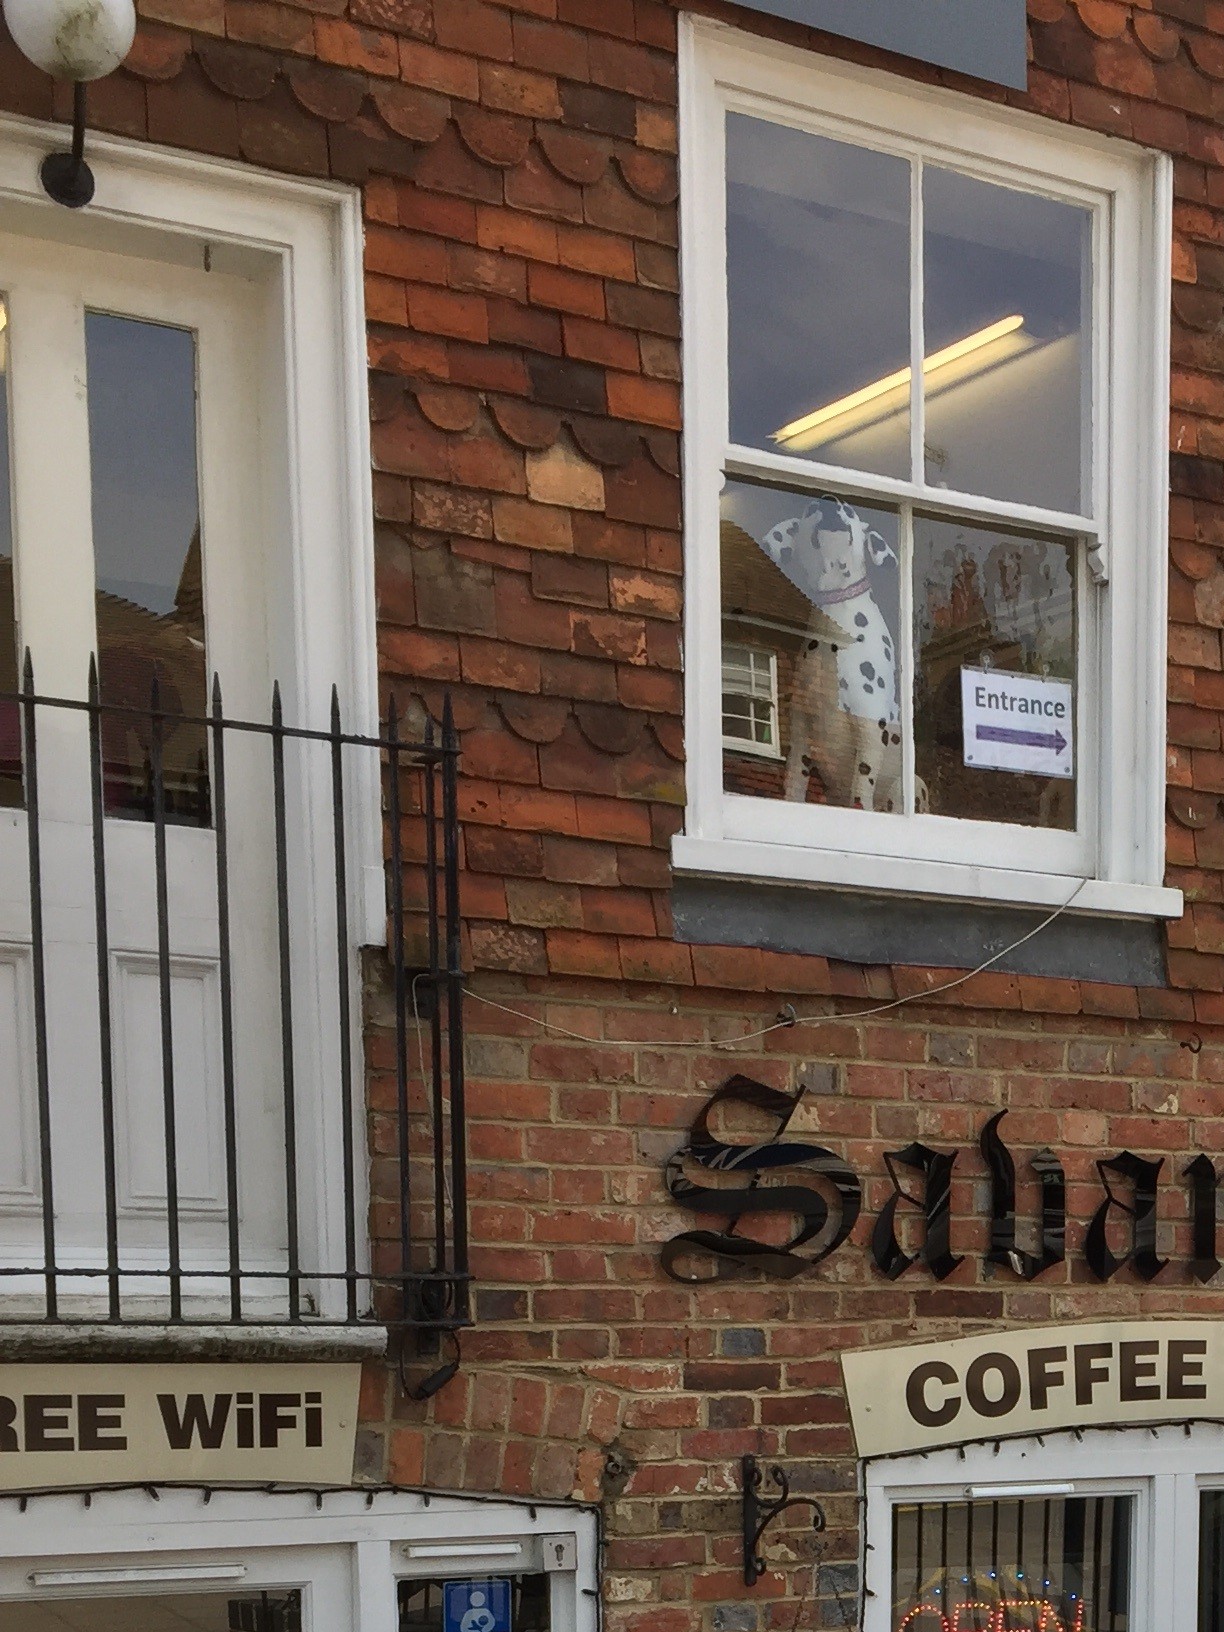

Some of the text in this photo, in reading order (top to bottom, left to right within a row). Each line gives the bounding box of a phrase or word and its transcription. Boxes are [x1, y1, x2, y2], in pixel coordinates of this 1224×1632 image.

[974, 686, 1067, 719] Entrance
[905, 1339, 1208, 1428] COFFEE
[0, 1391, 323, 1452] EE WiFi
